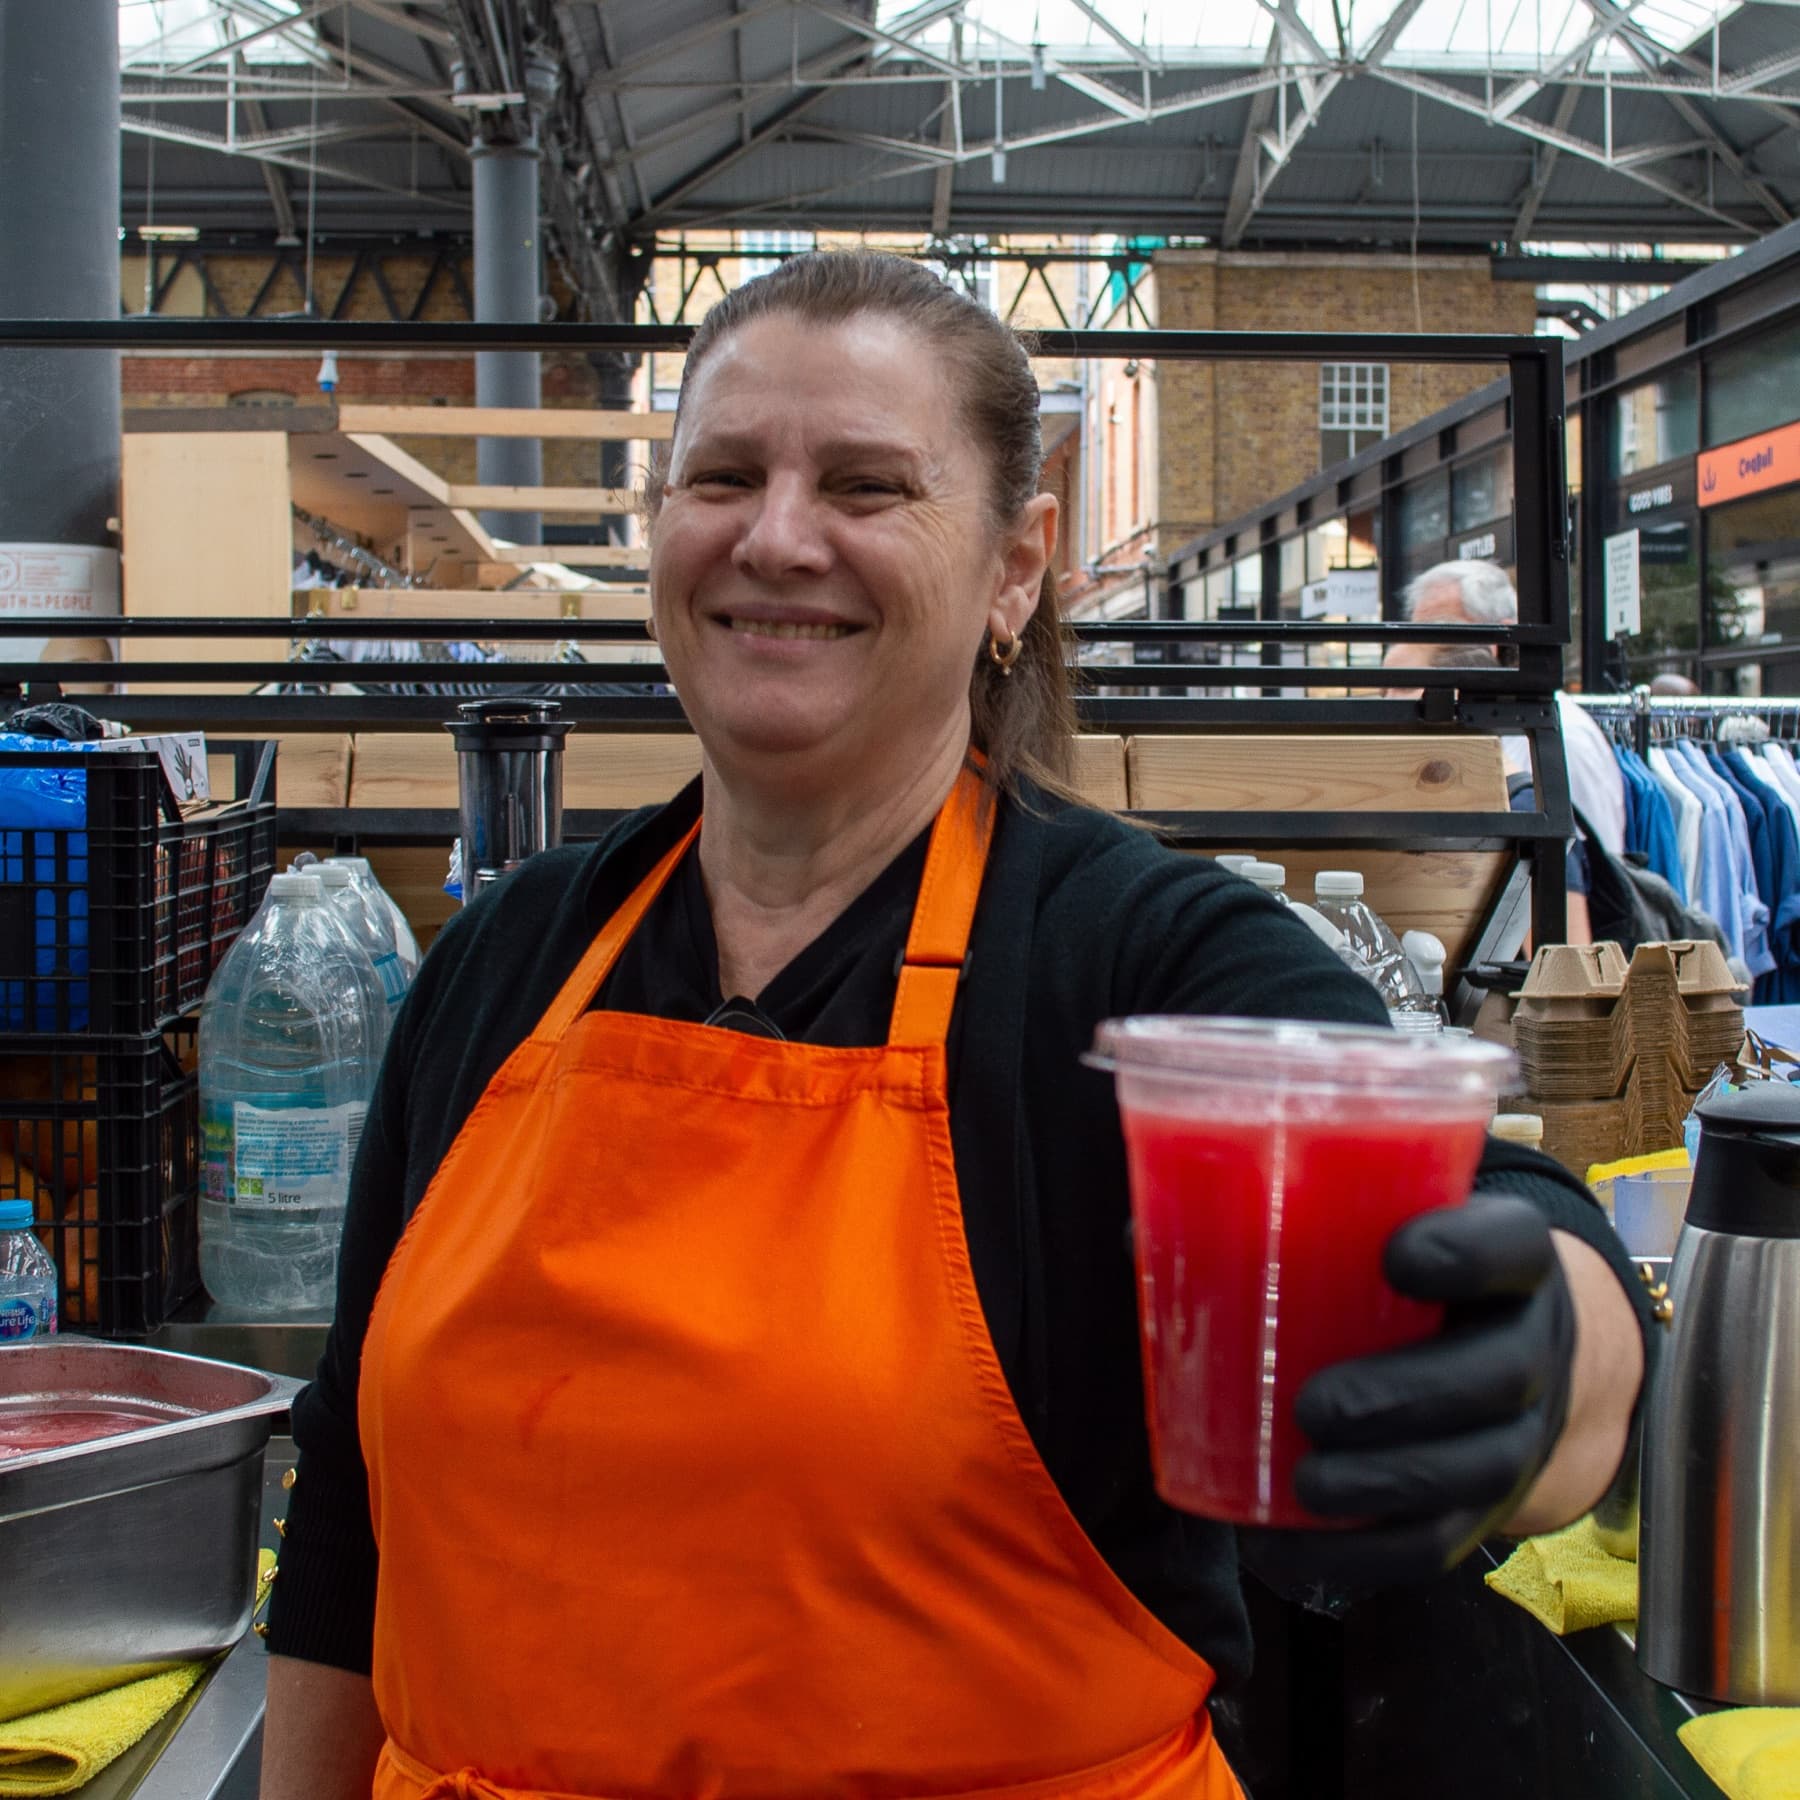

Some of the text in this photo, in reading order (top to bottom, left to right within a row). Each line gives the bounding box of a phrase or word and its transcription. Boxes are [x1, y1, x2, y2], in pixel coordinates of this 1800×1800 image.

[0, 594, 28, 609] UTH
[45, 593, 93, 611] PEOPLE
[268, 1192, 276, 1203] 5
[278, 1192, 301, 1203] litre
[0, 1315, 35, 1329] ure Life
